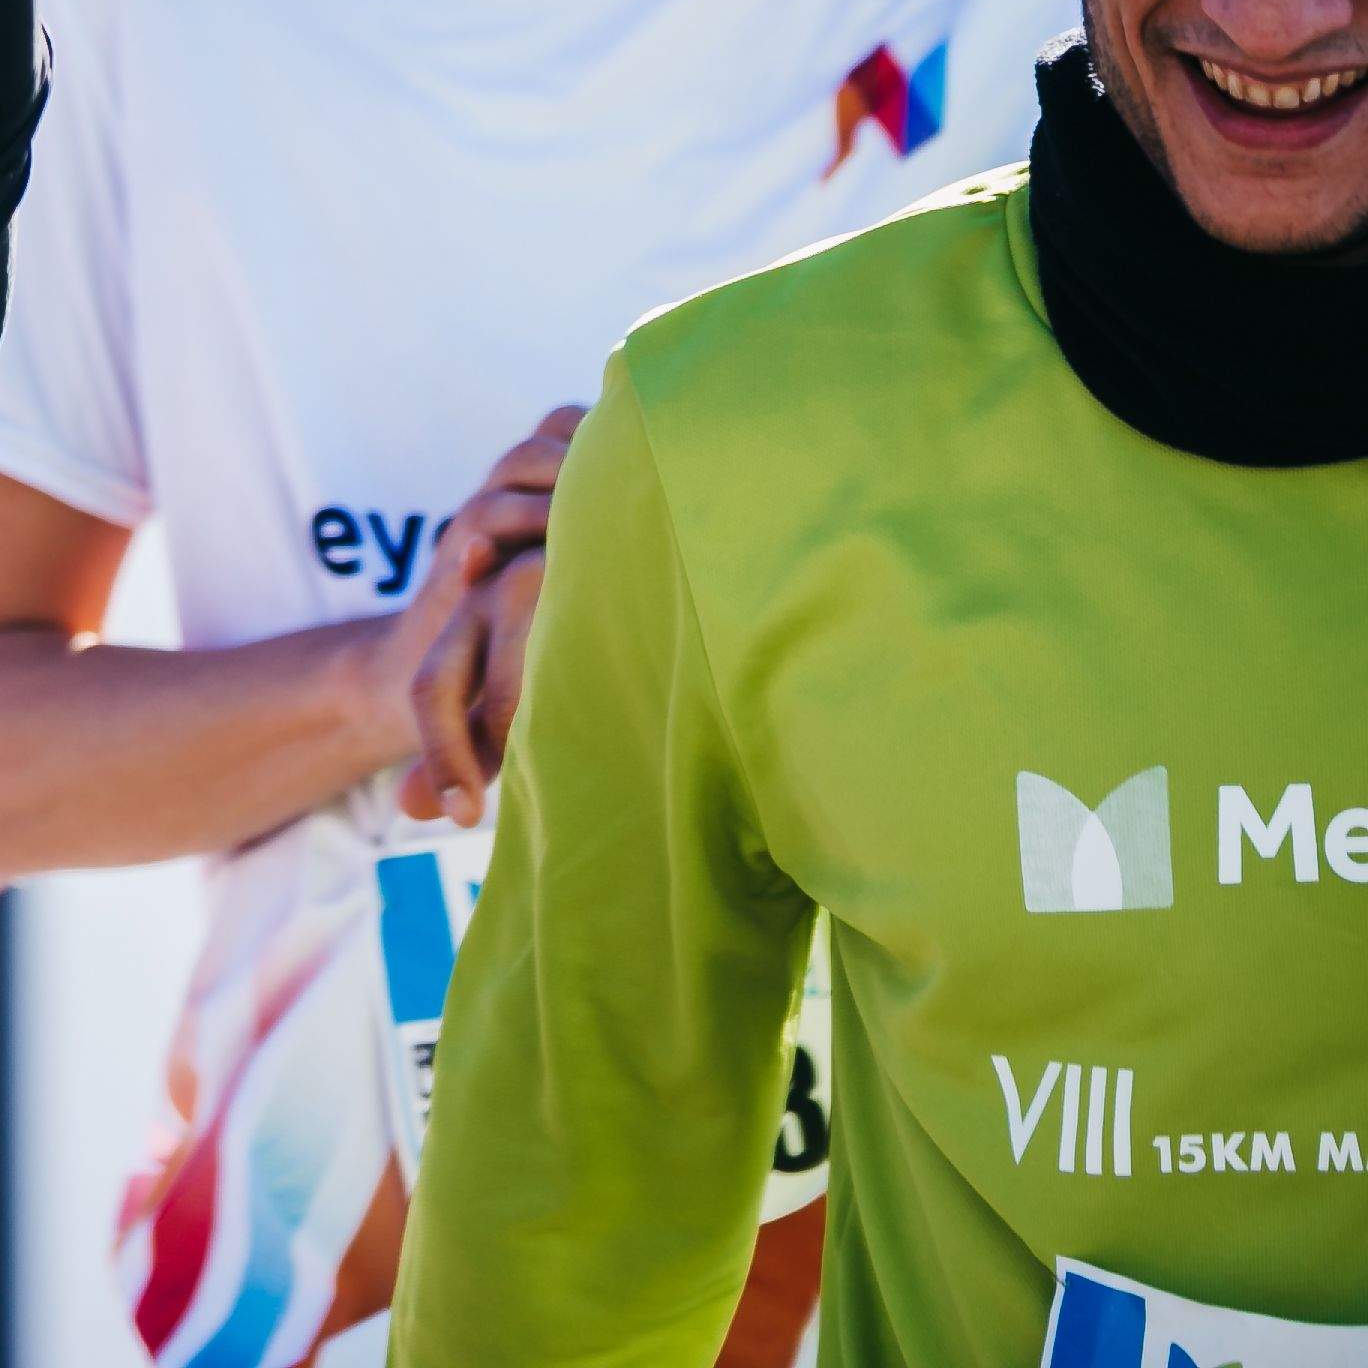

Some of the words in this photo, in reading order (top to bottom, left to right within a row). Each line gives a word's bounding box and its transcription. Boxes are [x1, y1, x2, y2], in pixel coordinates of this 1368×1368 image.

[312, 507, 455, 595] ey
[990, 1054, 1134, 1178] VIII
[1152, 1131, 1297, 1174] 15KM
[1317, 1131, 1368, 1173] M
